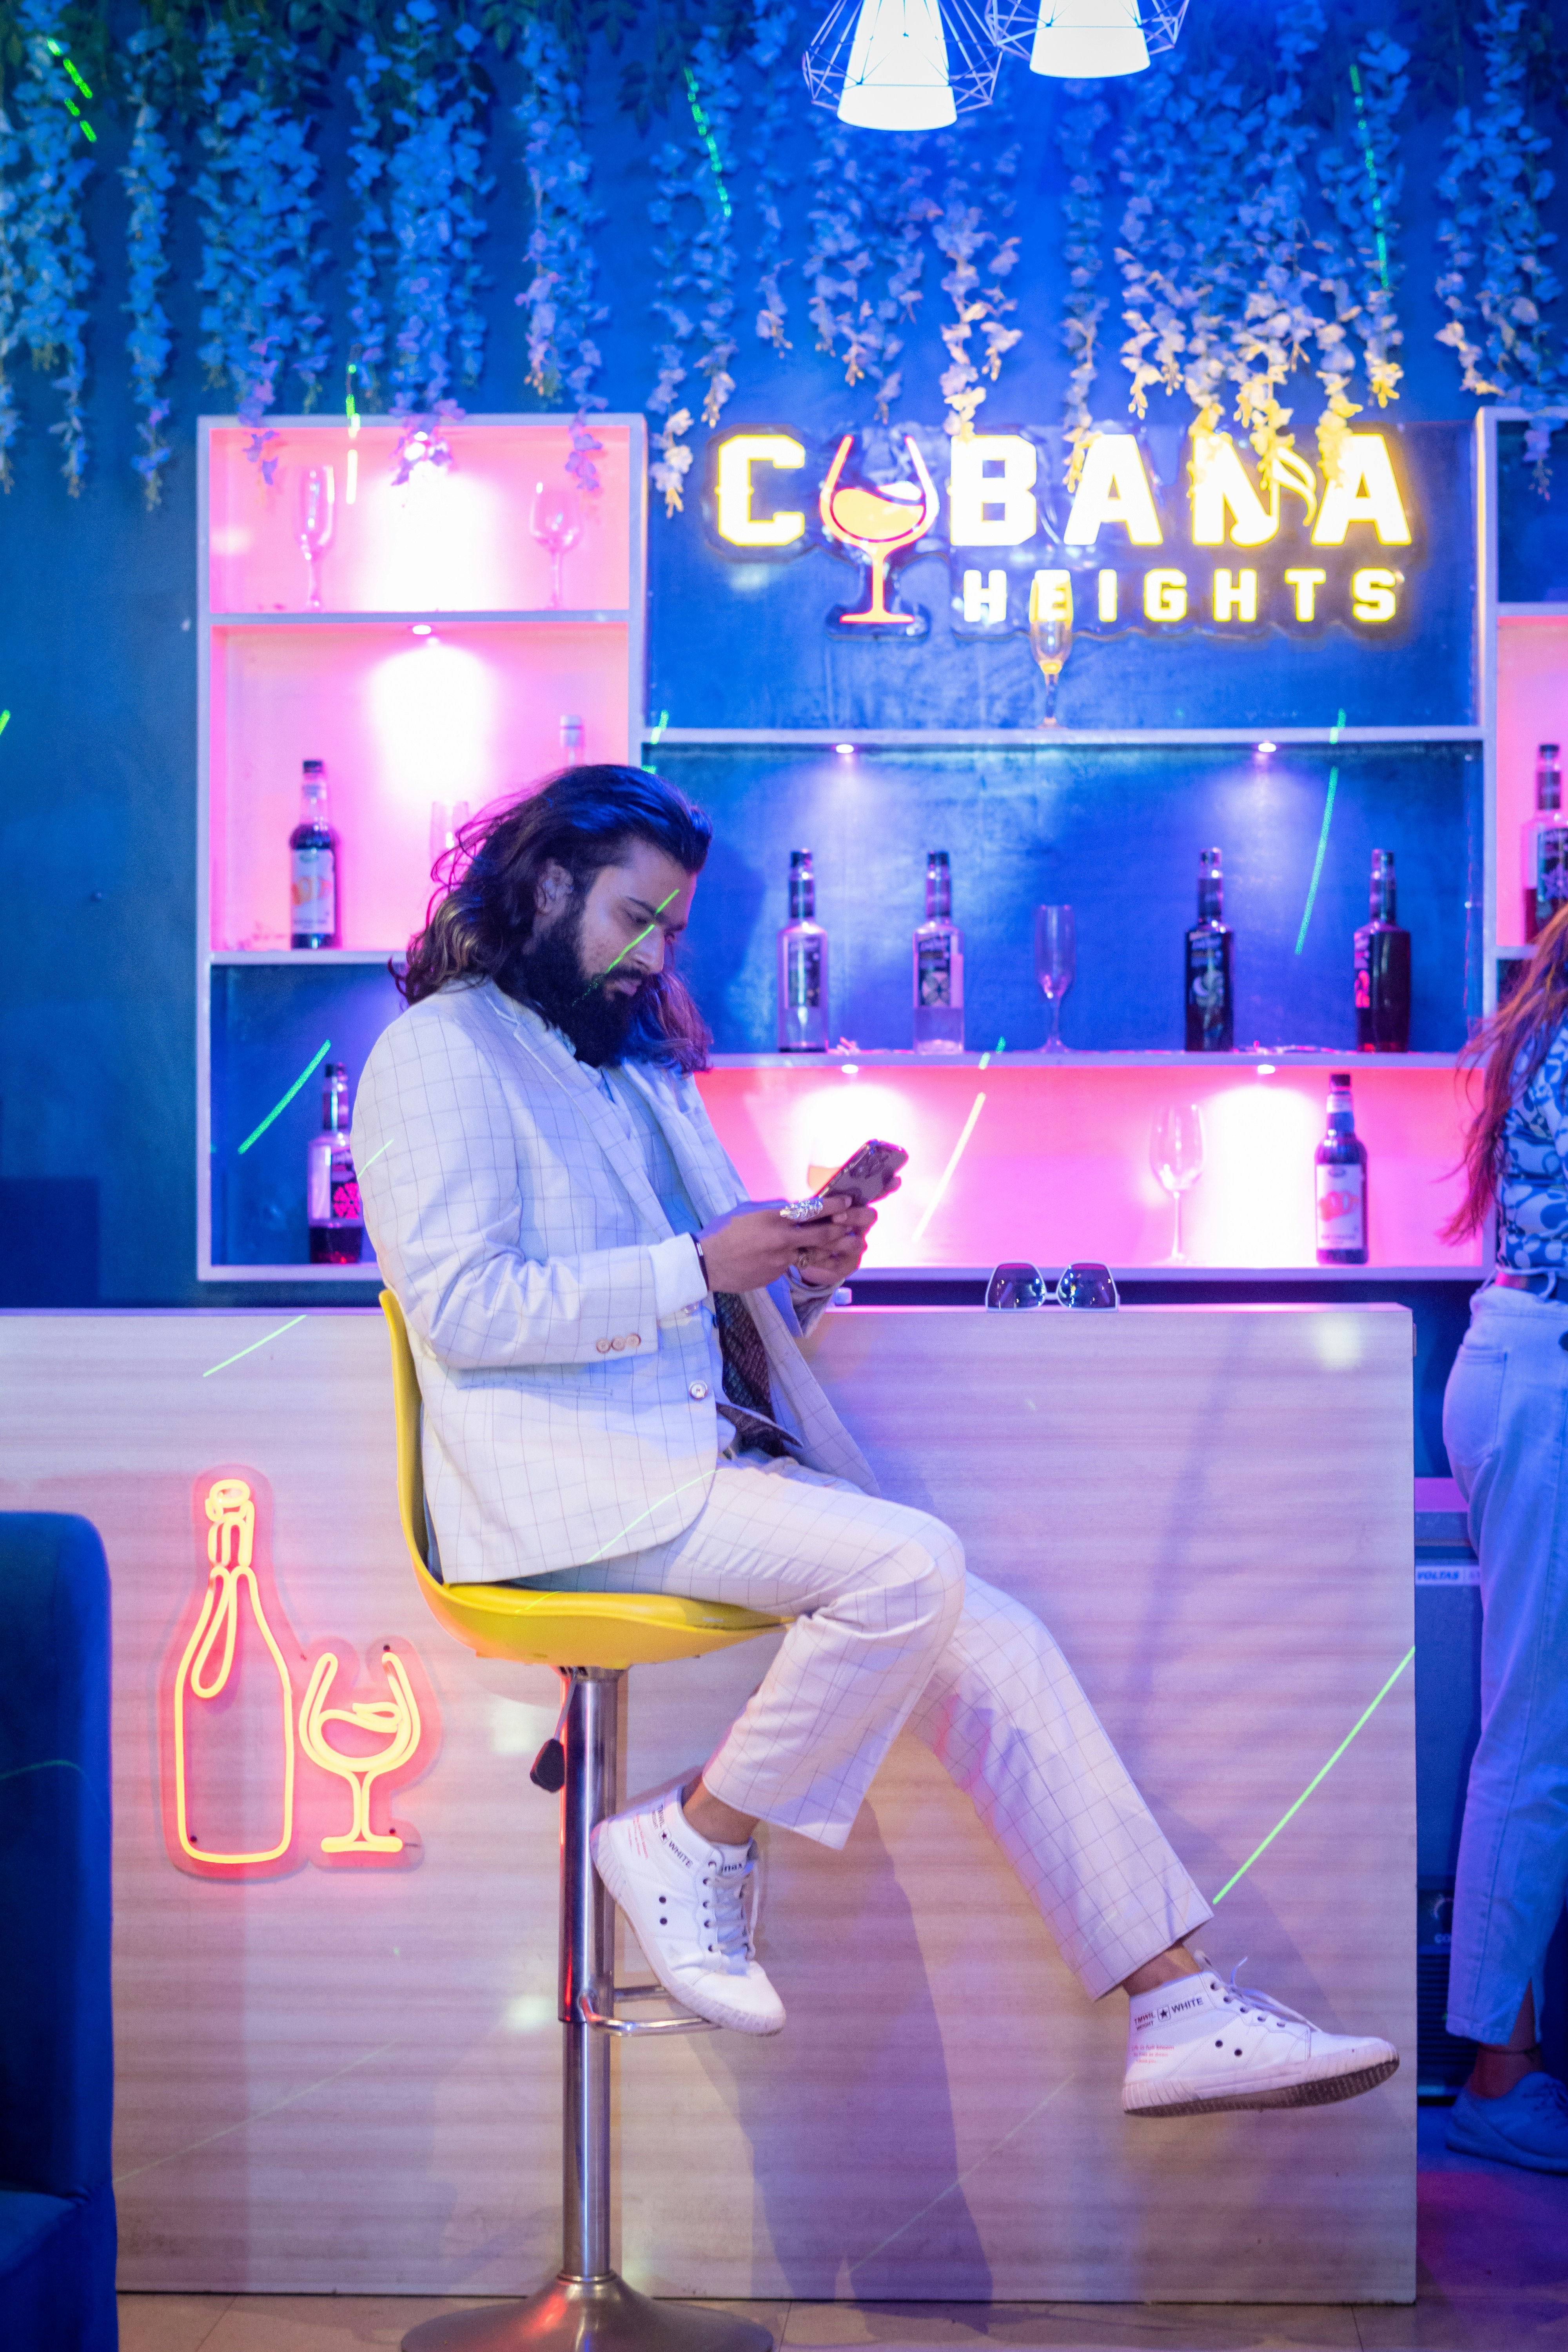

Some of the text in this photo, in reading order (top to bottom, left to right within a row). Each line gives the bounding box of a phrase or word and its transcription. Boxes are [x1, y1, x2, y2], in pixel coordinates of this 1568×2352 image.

[962, 569, 1397, 622] HEIGHTS
[669, 1840, 693, 1868] WHITE
[1171, 1997, 1203, 2013] WHITE
[1136, 2021, 1153, 2031] WEIGHT
